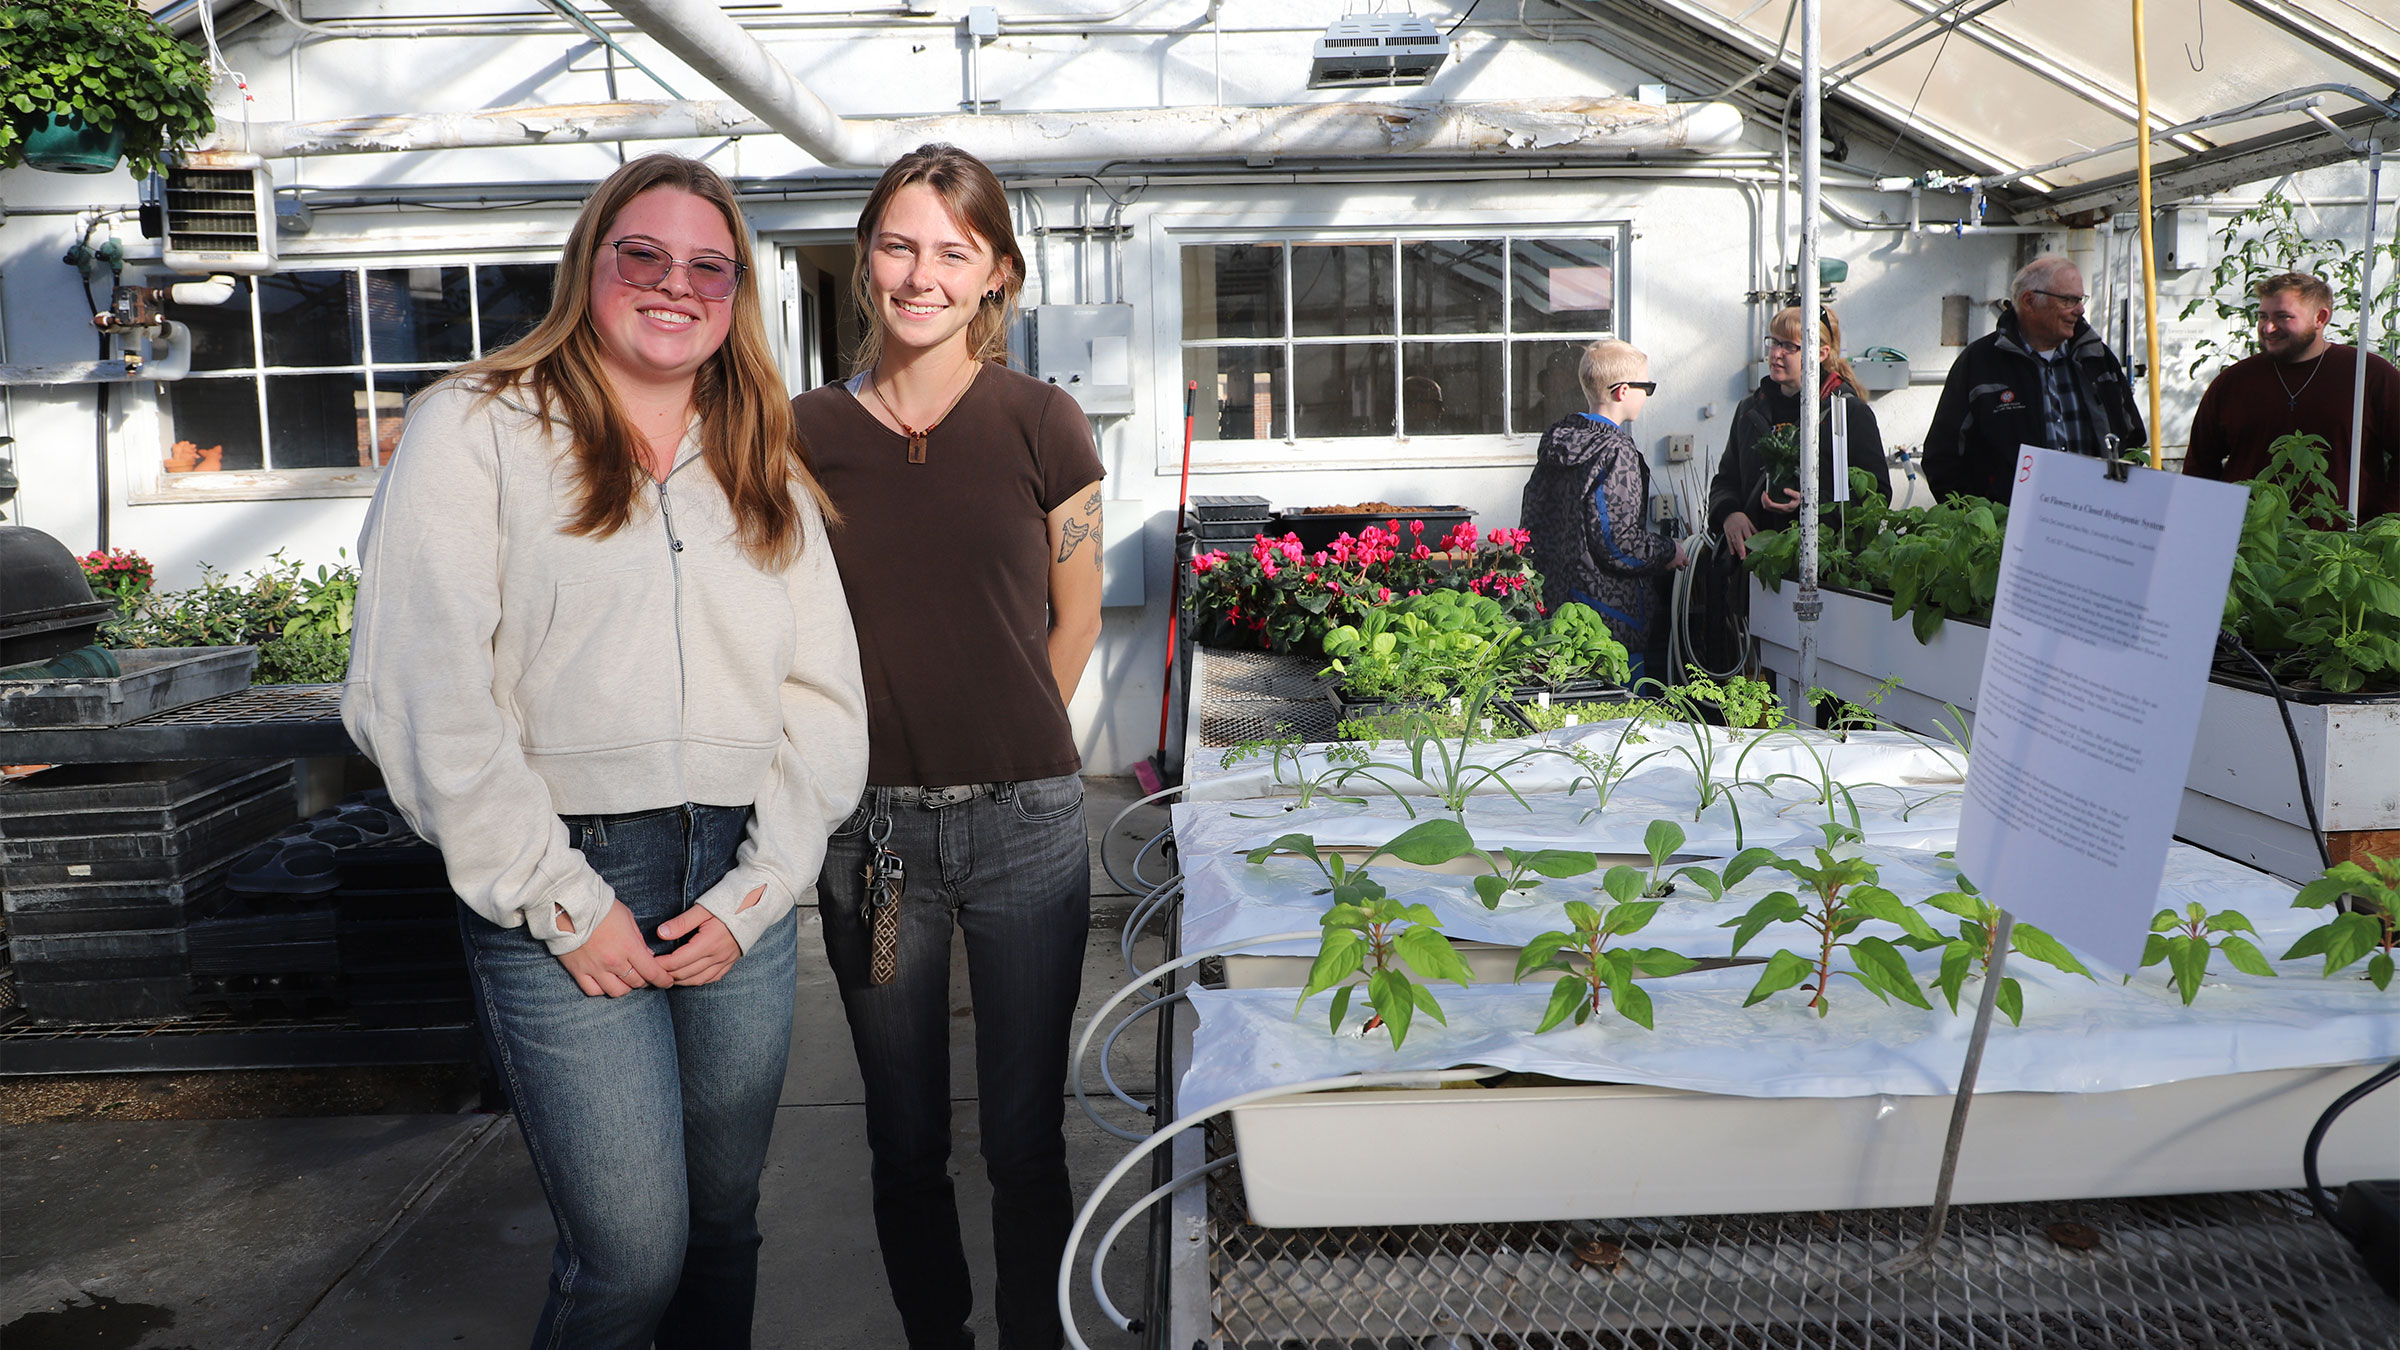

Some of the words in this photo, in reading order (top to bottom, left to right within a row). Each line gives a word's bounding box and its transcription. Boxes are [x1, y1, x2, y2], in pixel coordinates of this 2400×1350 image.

[2050, 496, 2071, 509] Flowers
[2083, 504, 2104, 517] Closed
[2104, 508, 2139, 525] Hydroponic
[2141, 518, 2166, 532] System
